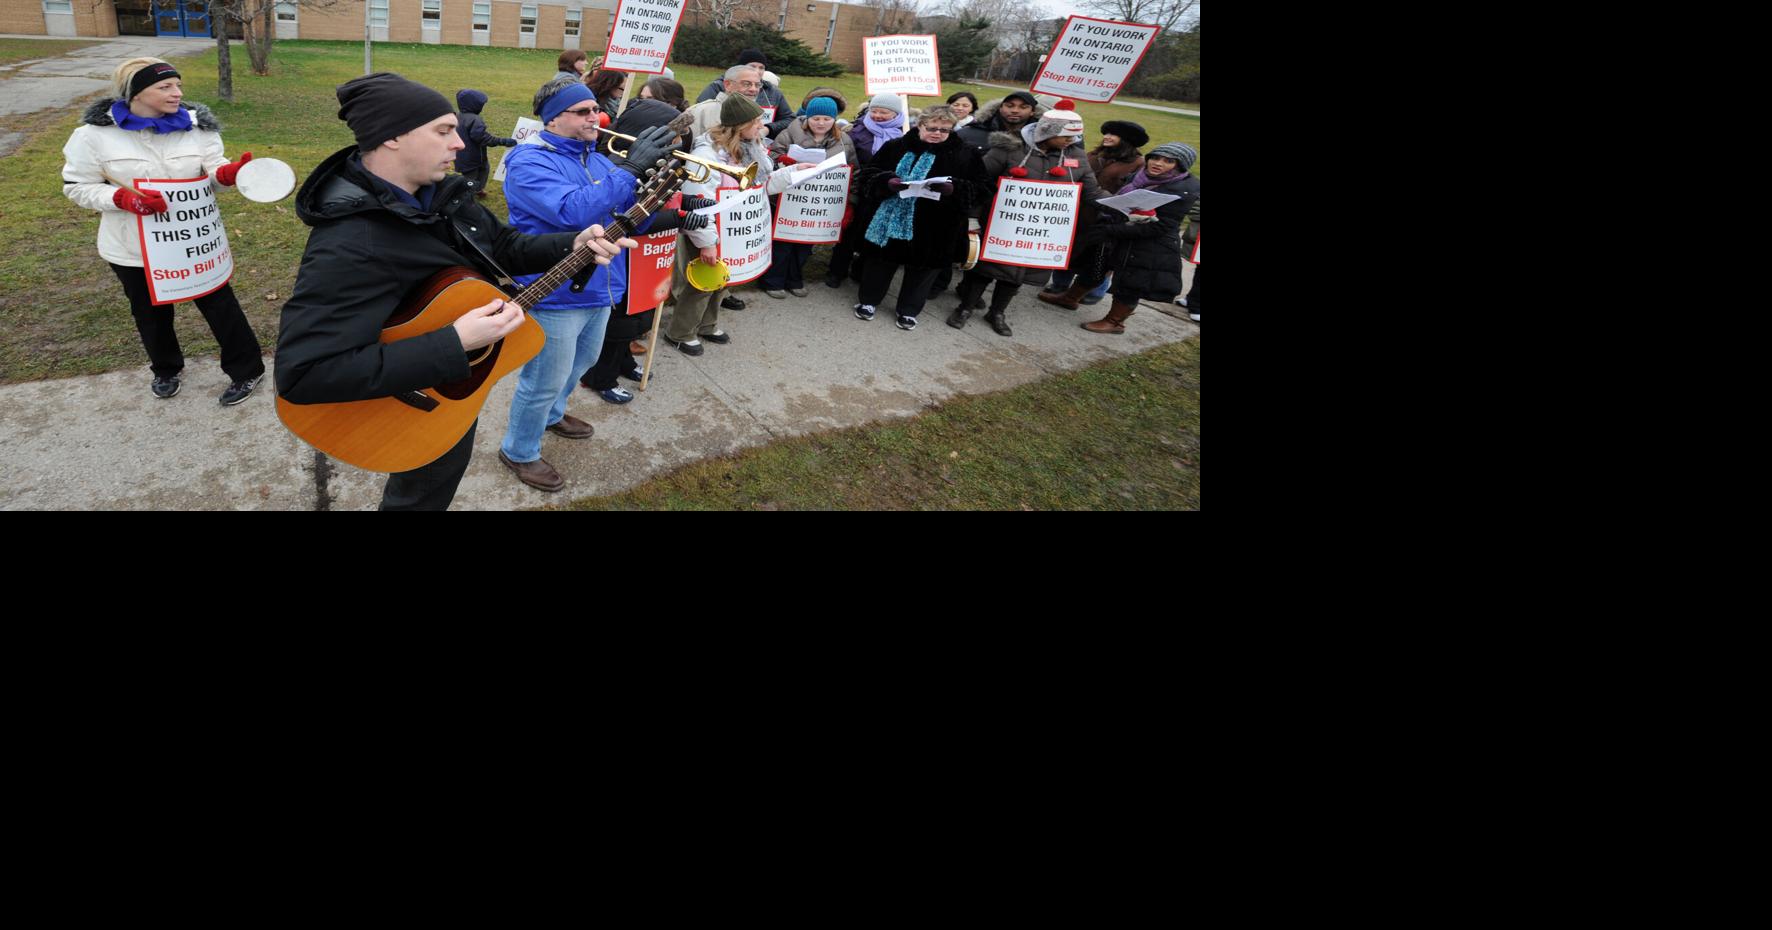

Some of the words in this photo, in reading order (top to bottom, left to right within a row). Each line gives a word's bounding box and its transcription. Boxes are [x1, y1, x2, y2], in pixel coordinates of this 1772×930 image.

[657, 0, 680, 8] WORK
[626, 6, 636, 15] IN
[637, 8, 672, 22] ONTARIO,
[620, 19, 640, 29] THIS
[641, 22, 649, 31] IS
[651, 24, 671, 34] YOUR
[1073, 23, 1085, 32] IF
[1087, 25, 1111, 36] YOU
[1111, 28, 1148, 40] WORK
[631, 35, 654, 44] FIGHT.
[1068, 36, 1080, 45] IN
[1083, 38, 1134, 54] ONTARIO,
[610, 45, 627, 56] Stop
[643, 49, 665, 59] 115.ca
[1060, 48, 1085, 59] THIS
[1086, 52, 1098, 61] IS
[1101, 54, 1131, 65] YOUR
[1070, 63, 1104, 75] FIGHT.
[1042, 70, 1065, 82] Stop
[1067, 75, 1083, 84] Bill
[1086, 79, 1118, 90] 115.ca
[825, 172, 847, 180] WORK
[805, 184, 843, 193] ONTARIO,
[1005, 185, 1016, 193] IF
[1019, 186, 1042, 196] YOU
[1045, 188, 1074, 198] WORK
[165, 189, 200, 203] YOU
[743, 194, 761, 205] OU
[787, 194, 808, 203] THIS
[823, 197, 844, 205] YOUR
[800, 208, 828, 217] FIGHT.
[1004, 198, 1017, 207] IN
[1020, 200, 1070, 213] ONTARIO,
[153, 211, 170, 222] IN
[729, 212, 741, 221] IN
[777, 217, 798, 228] Stop
[999, 211, 1025, 222] THIS
[1028, 215, 1040, 223] IS
[1043, 216, 1070, 225] YOUR
[152, 229, 191, 242] THIS
[196, 225, 210, 237] IS
[726, 226, 752, 236] THIS
[755, 223, 761, 233] IS
[1016, 227, 1050, 238] FIGHT.
[643, 240, 676, 256] Barga
[988, 236, 1012, 248] Stop
[1015, 240, 1033, 249] Bill
[1036, 242, 1068, 252] 115.ca
[656, 253, 675, 269] Rig
[722, 256, 745, 267] Stop
[748, 251, 759, 263] Bill
[153, 268, 190, 280] Stop
[194, 259, 215, 274] Bill
